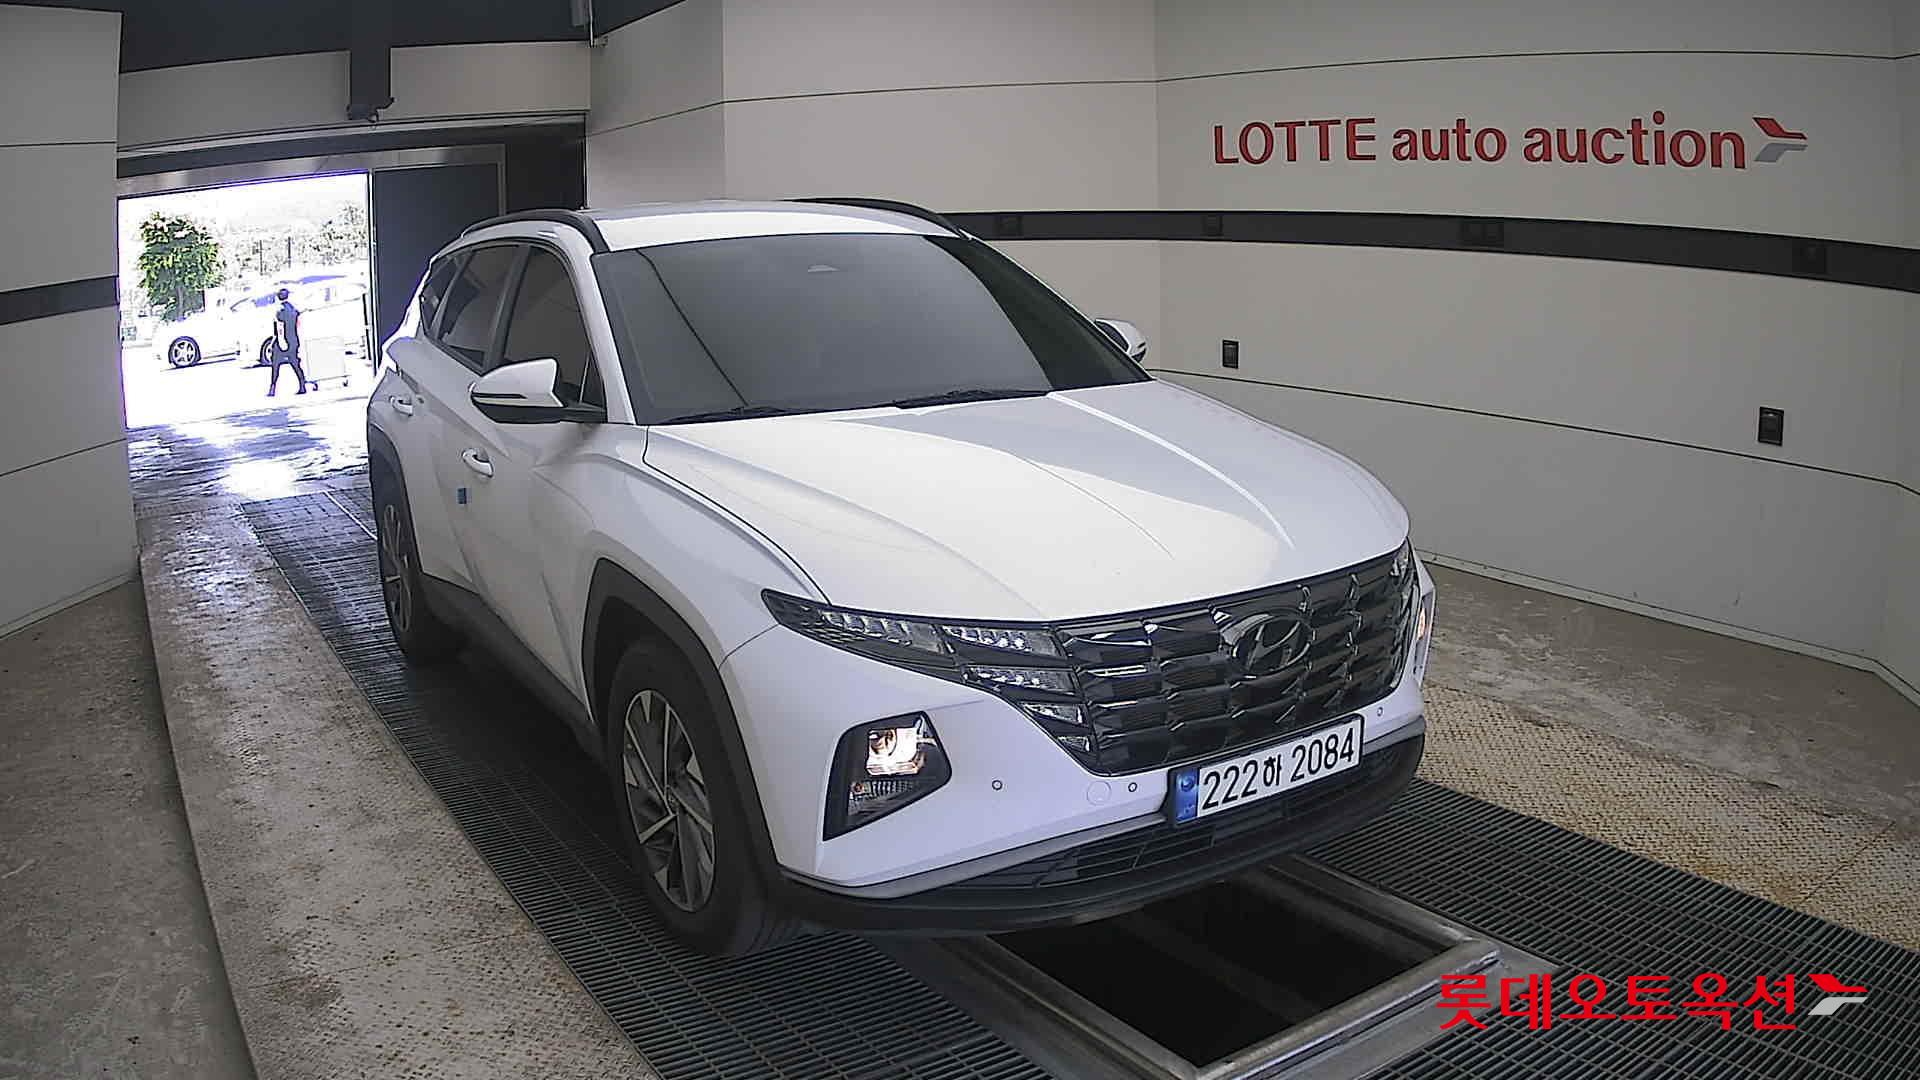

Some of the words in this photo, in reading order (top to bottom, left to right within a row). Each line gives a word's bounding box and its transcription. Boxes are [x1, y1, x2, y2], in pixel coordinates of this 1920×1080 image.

[1213, 118, 1377, 165] LOTTE
[1391, 117, 1508, 164] auto
[1522, 110, 1747, 169] auction
[1201, 754, 1282, 811] 222하
[1290, 727, 1355, 783] 2084
